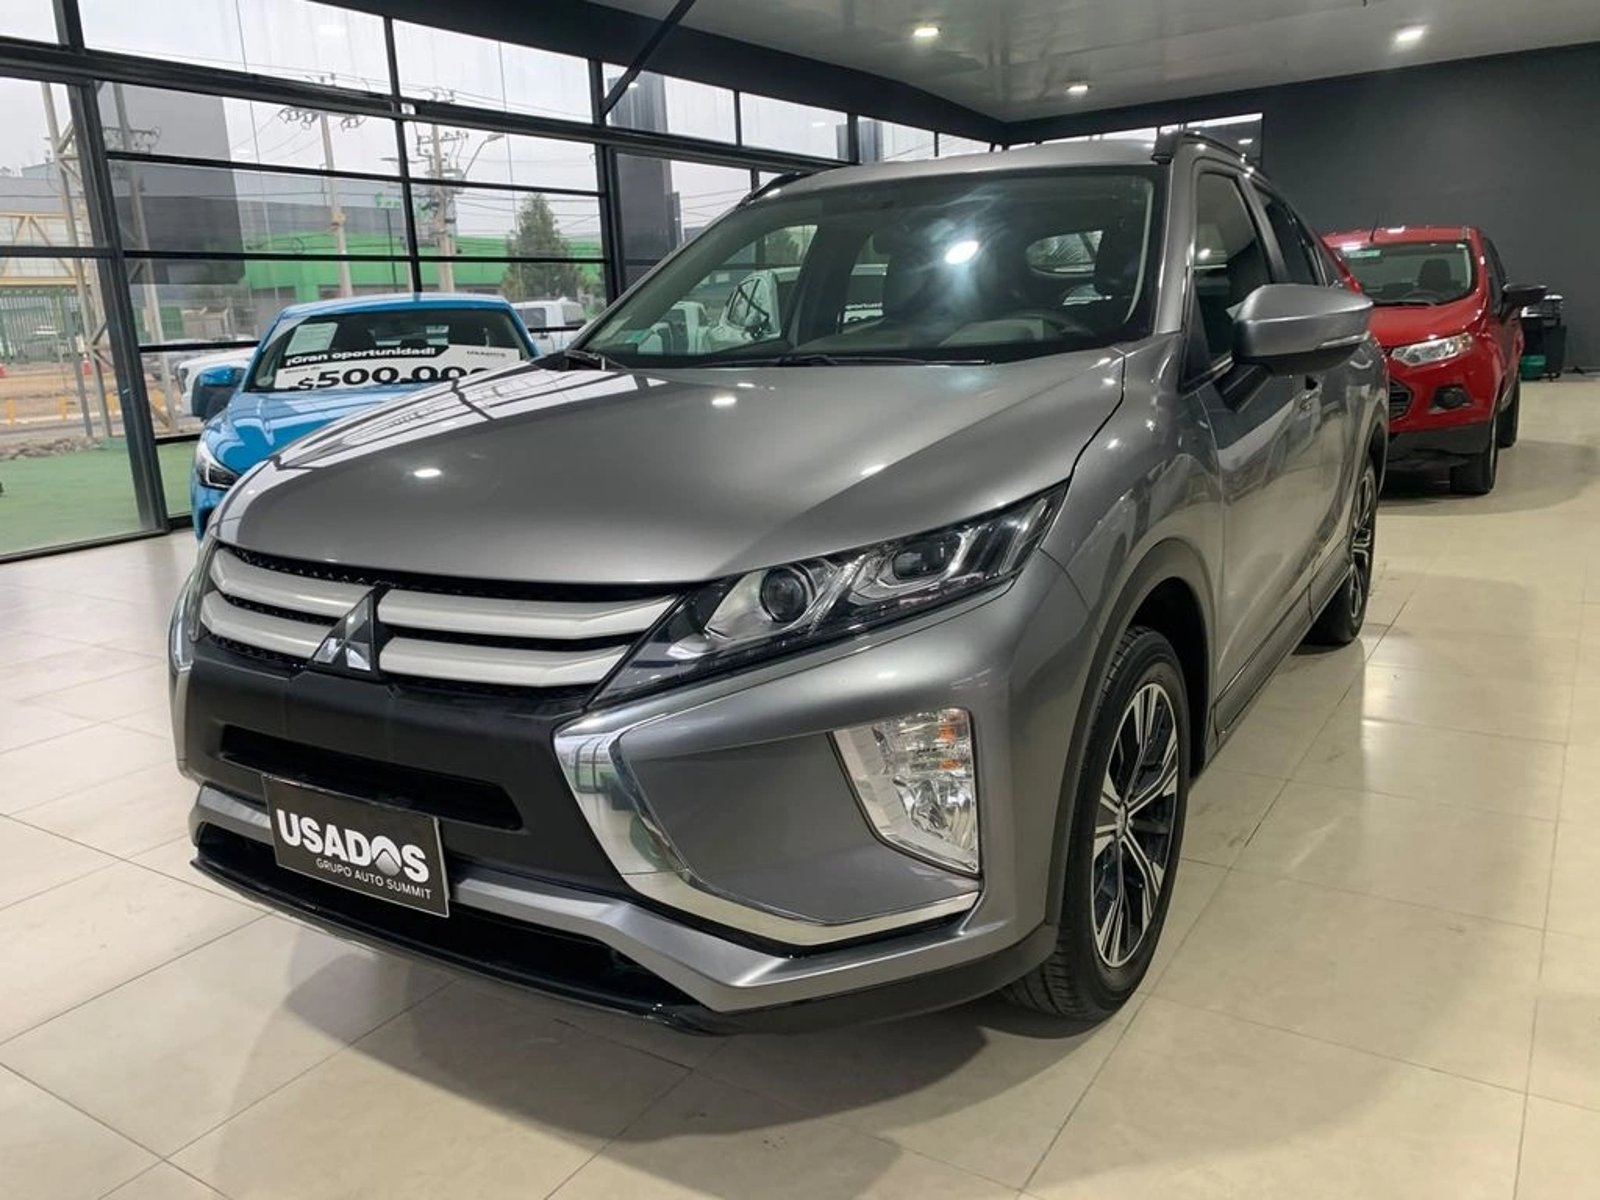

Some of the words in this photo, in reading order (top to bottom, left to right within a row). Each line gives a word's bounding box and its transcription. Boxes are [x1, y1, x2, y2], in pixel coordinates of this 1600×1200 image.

[285, 352, 328, 366] ¡Gran
[331, 346, 436, 360] oportunidad!
[297, 366, 489, 390] $500.00
[276, 809, 429, 883] USADOS
[316, 857, 352, 877] GRUPO
[354, 870, 384, 887] AUTO
[386, 879, 432, 899] SUMMIT
